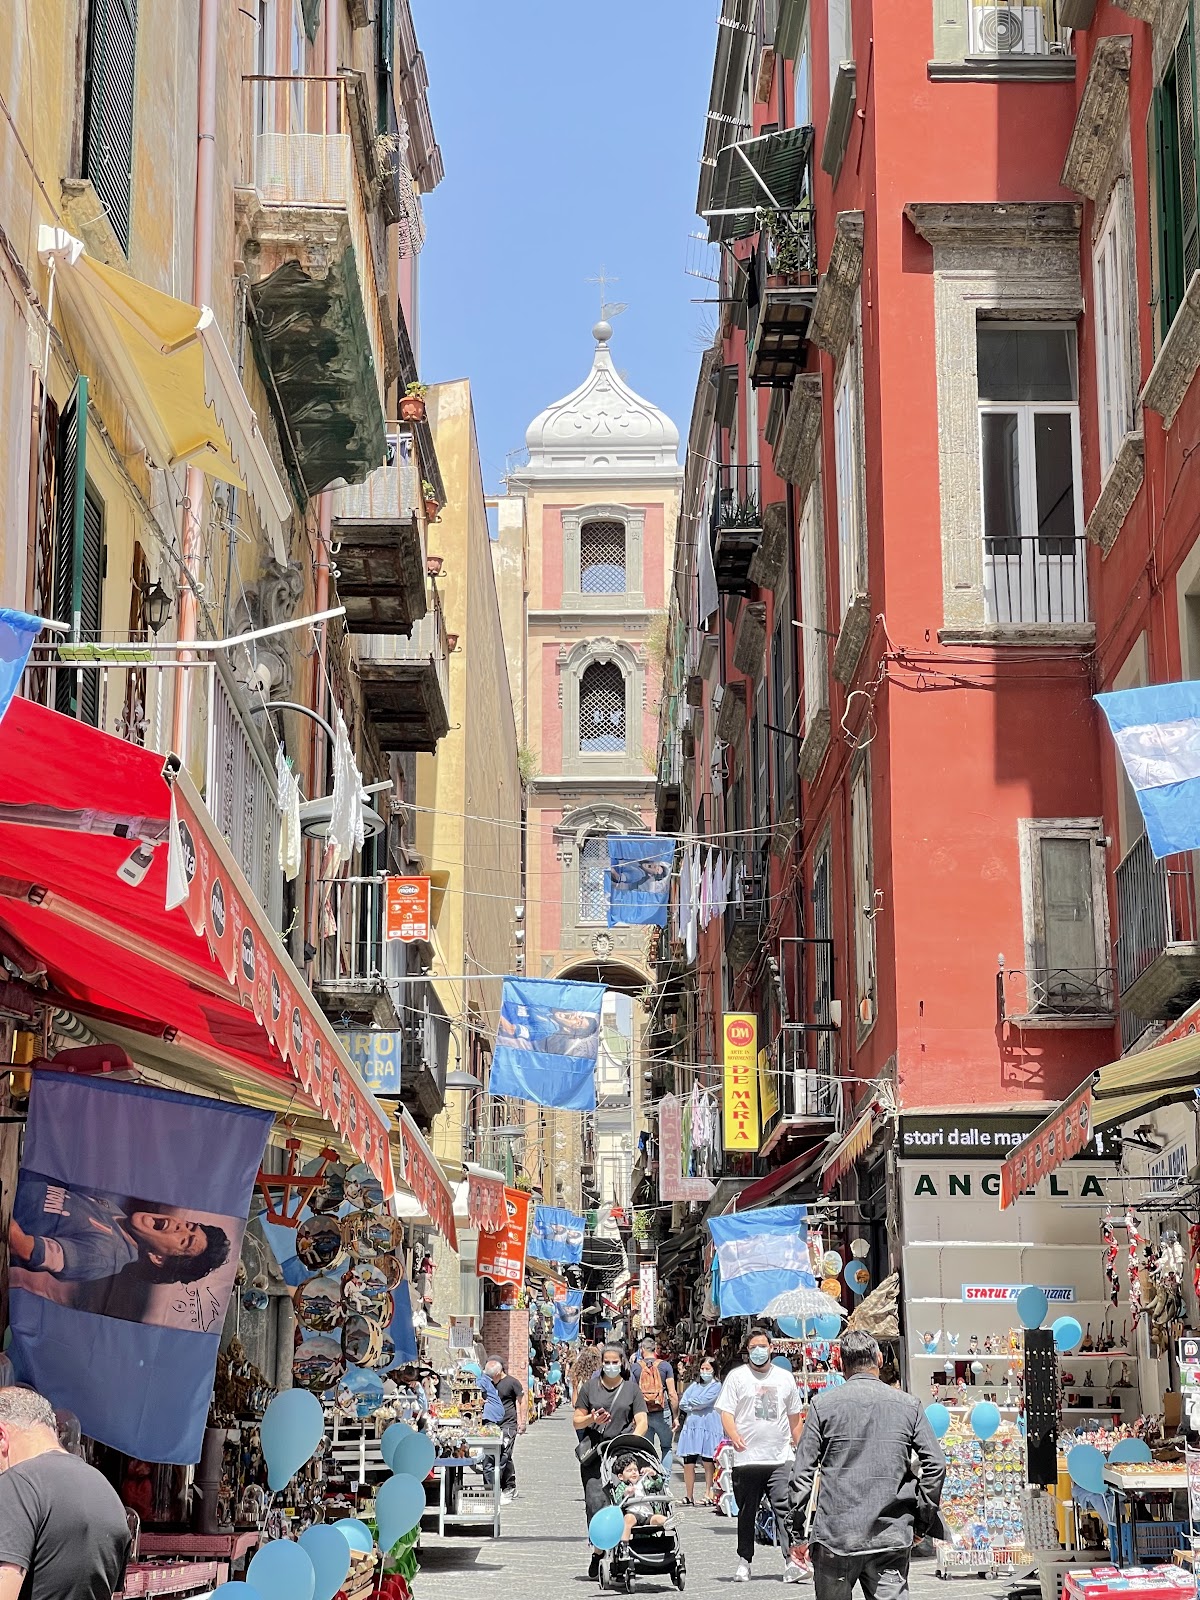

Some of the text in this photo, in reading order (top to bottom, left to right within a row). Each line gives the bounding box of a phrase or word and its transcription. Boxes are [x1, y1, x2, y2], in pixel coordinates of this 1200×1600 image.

[354, 1060, 395, 1076] ACRA
[732, 1065, 750, 1084] DE
[731, 1090, 751, 1140] MARIA
[948, 1128, 991, 1145] dalle
[914, 1174, 1104, 1197] ANGLA
[967, 1288, 1008, 1298] STATUE
